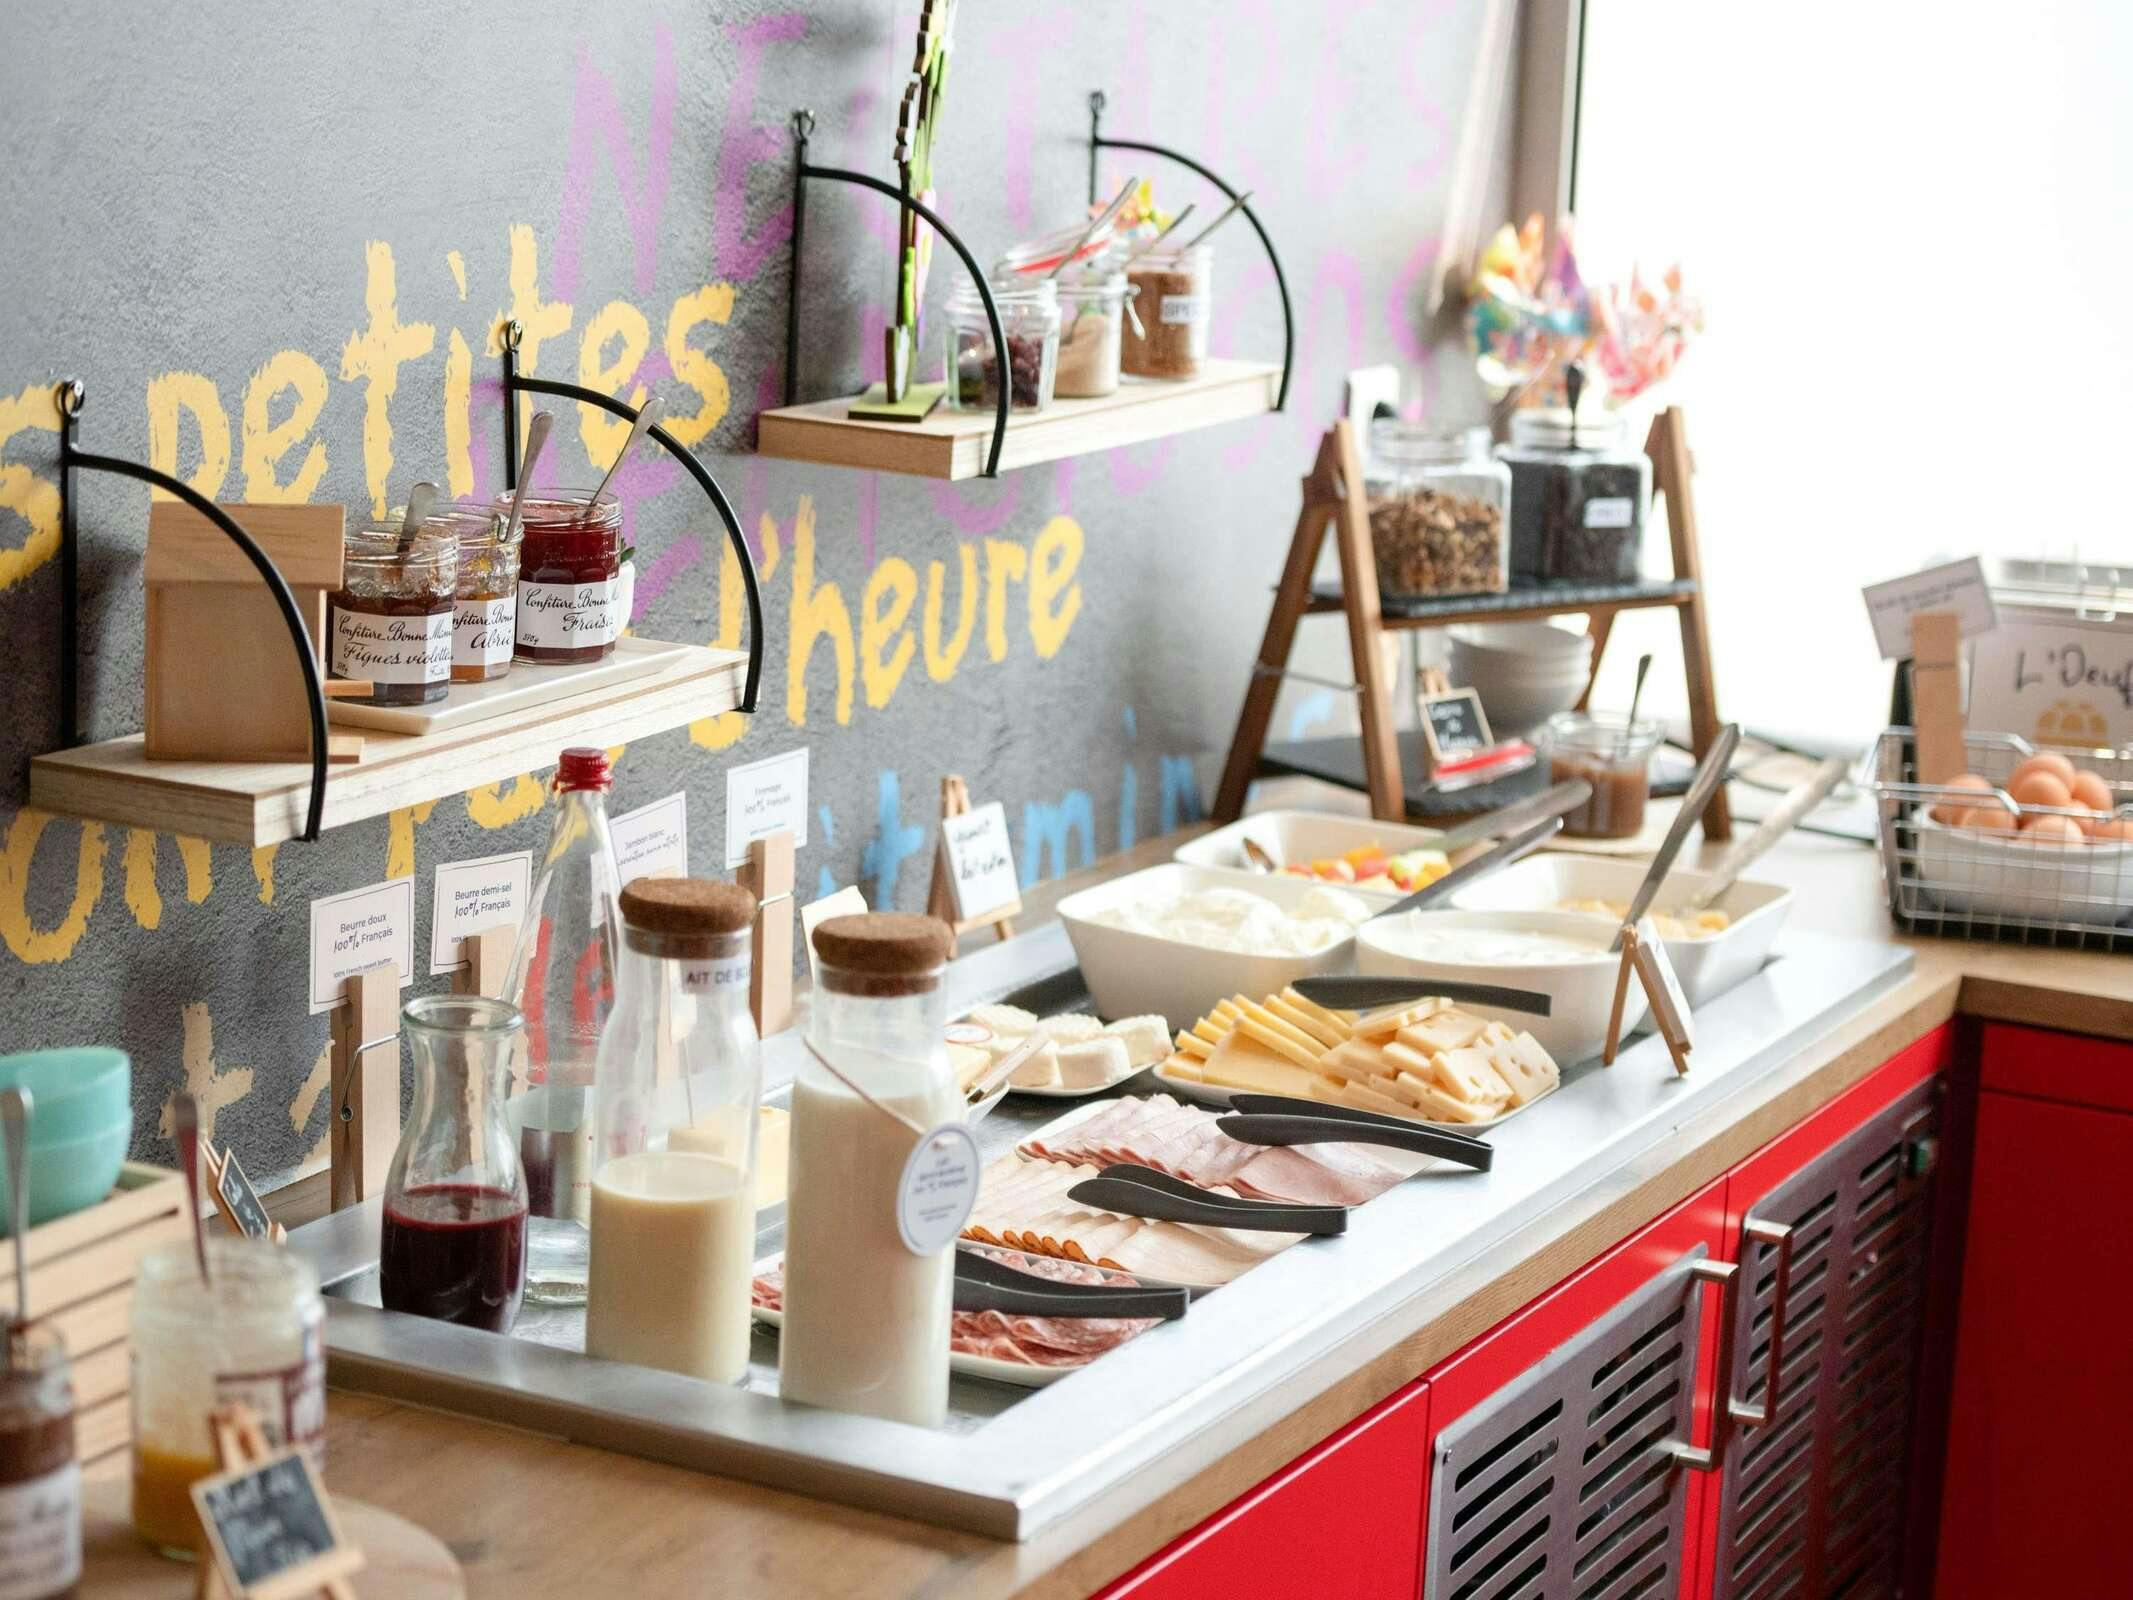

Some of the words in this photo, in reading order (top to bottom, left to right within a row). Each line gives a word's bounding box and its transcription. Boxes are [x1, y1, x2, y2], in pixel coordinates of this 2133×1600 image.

[525, 587, 576, 613] Confiture
[386, 620, 428, 642] Bonne
[454, 889, 480, 901] Beurre
[480, 881, 513, 897] demi-sel
[454, 897, 480, 919] 100%
[480, 898, 511, 913] Français
[340, 919, 367, 934] Beurre
[367, 912, 388, 926] doux
[333, 930, 360, 954] 100%
[360, 926, 393, 945] Français
